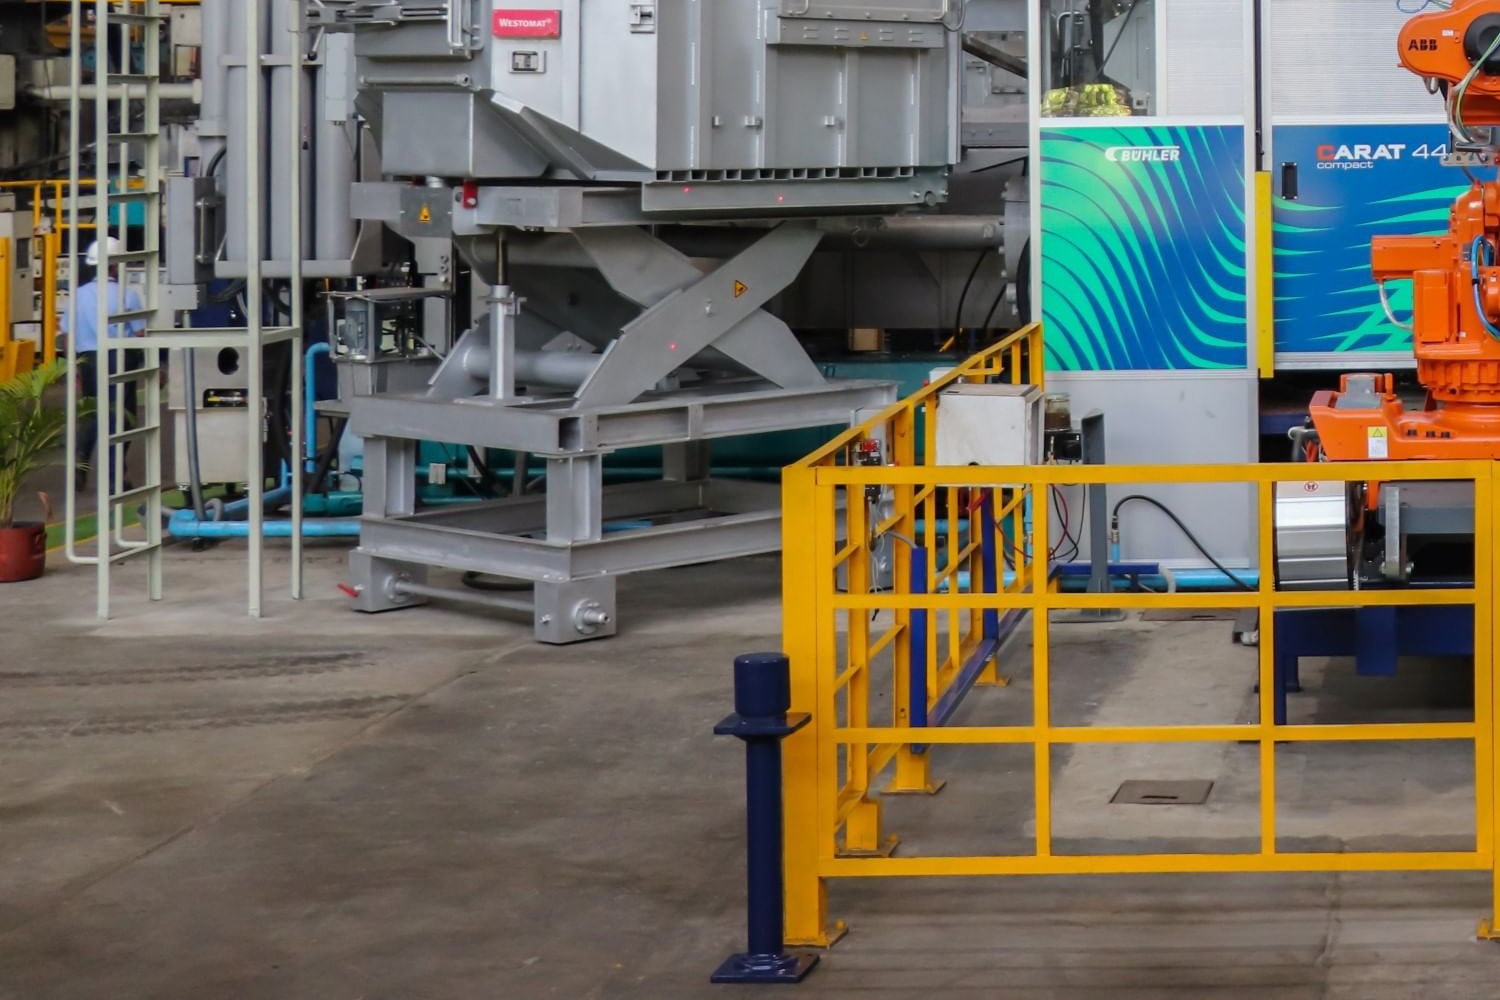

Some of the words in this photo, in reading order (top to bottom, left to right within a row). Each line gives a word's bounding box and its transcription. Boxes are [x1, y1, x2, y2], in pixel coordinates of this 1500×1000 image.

[1408, 39, 1438, 51] ABB
[1121, 149, 1180, 161] BÜHLER
[1316, 144, 1406, 161] CARAT
[1316, 161, 1374, 170] compact
